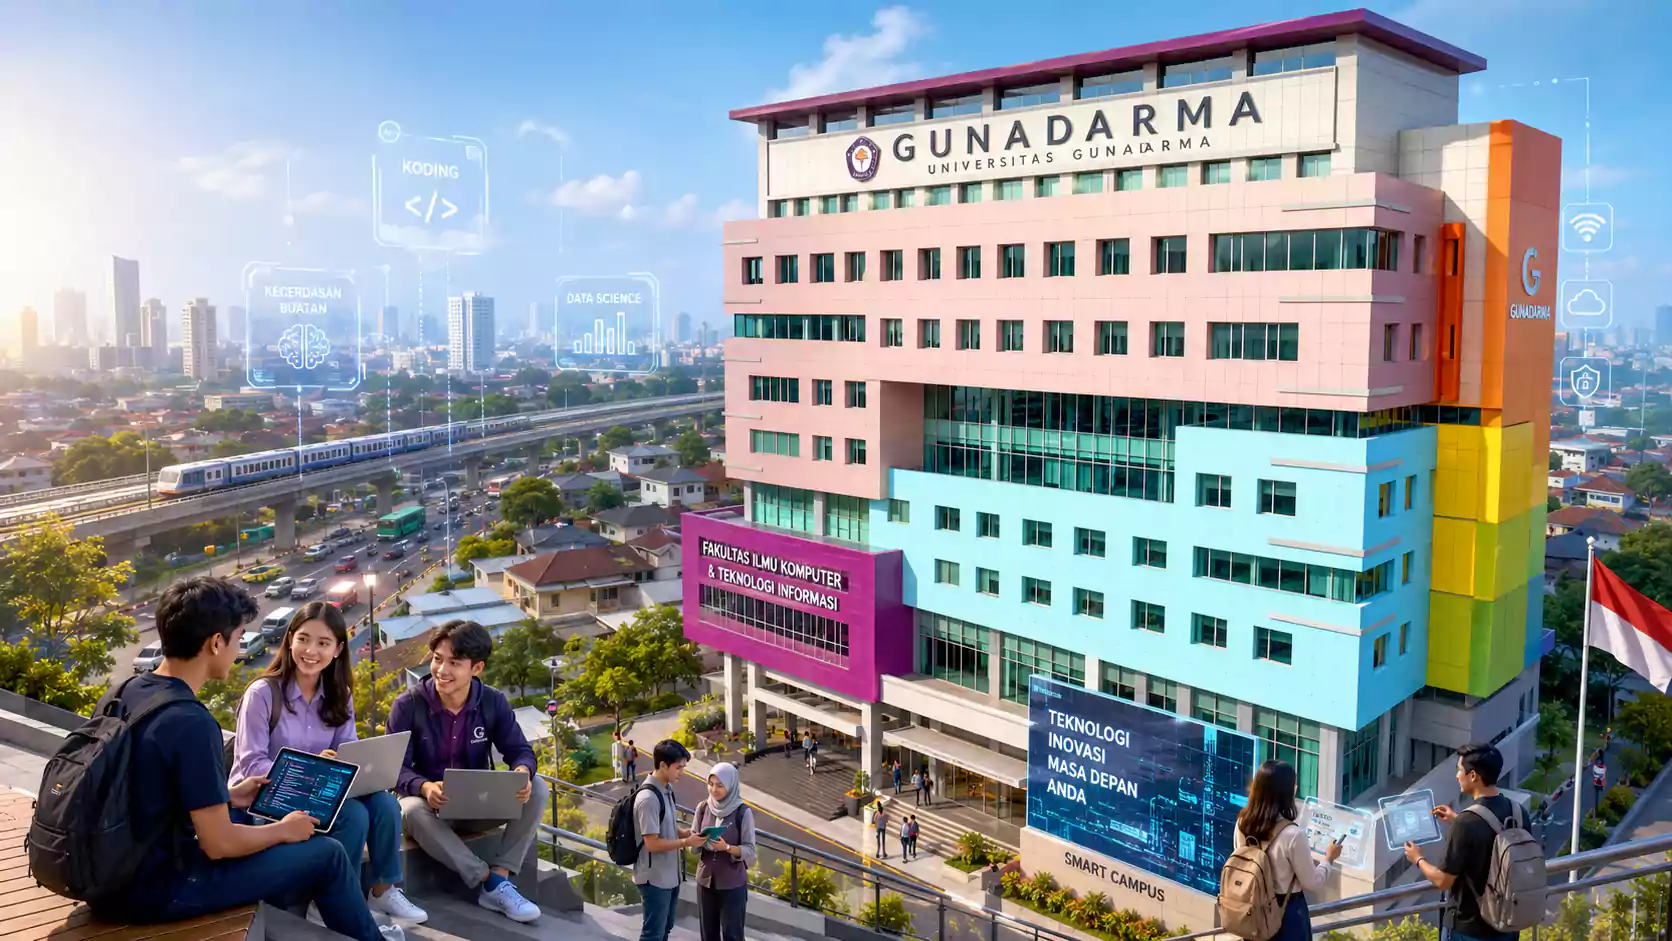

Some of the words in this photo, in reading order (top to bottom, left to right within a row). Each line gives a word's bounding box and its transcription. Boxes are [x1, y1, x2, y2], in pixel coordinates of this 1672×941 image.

[892, 90, 1263, 162] GUNADARMA
[927, 151, 1055, 175] UNIVERSITAS
[1522, 247, 1541, 296] G
[702, 540, 750, 565] FAKULTAS
[752, 554, 778, 572] ILMU
[780, 560, 842, 589] KOMPUTER
[708, 564, 715, 579] &
[718, 567, 775, 594] TEKNOLOGI
[777, 584, 838, 611] INFORMASI
[1048, 709, 1130, 748] TEKNOLOGI
[1048, 731, 1106, 765] INOVASI
[1046, 778, 1087, 805] ANDA
[1047, 754, 1087, 782] MASA
[1090, 770, 1139, 799] DEPAN
[1064, 851, 1108, 879] SMART
[1110, 870, 1166, 902] CAMPUS
